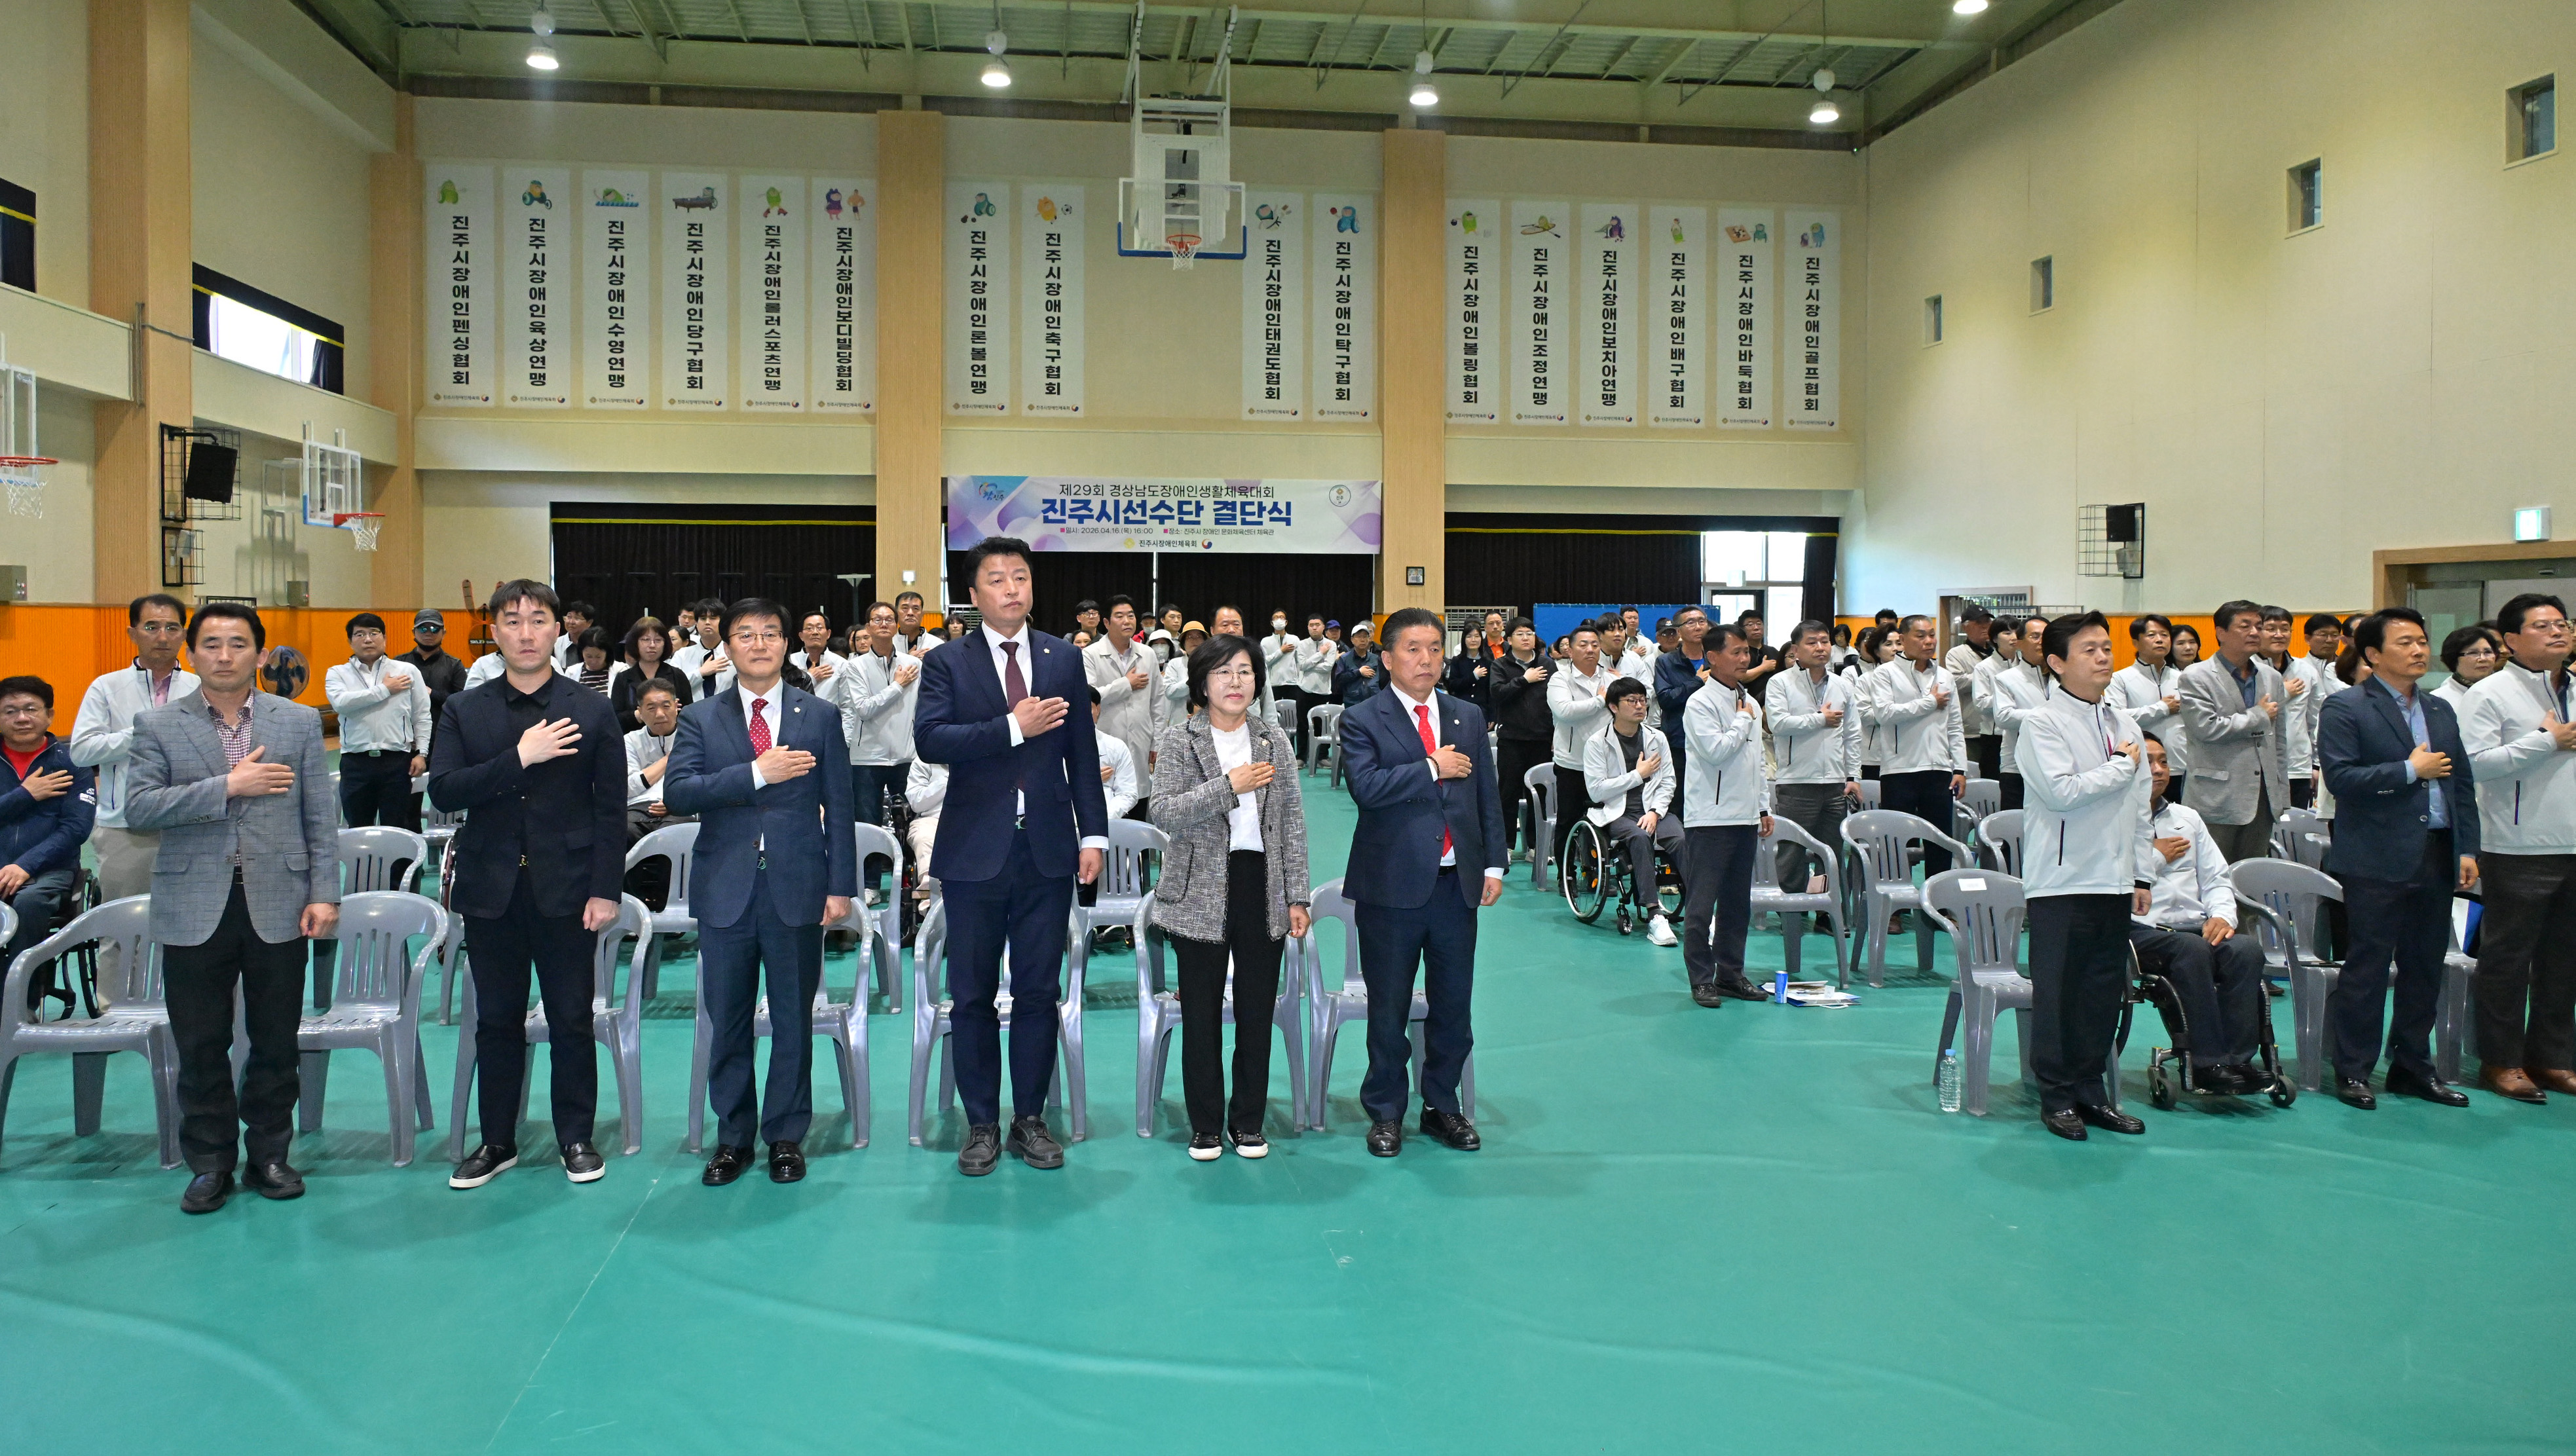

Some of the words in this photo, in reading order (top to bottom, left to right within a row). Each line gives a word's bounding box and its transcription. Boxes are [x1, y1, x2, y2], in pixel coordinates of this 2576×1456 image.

[452, 215, 471, 385] 진주시장애인펜싱협회
[529, 218, 547, 386] 진주시장애인육상연맹
[607, 220, 625, 388] 진주시장애인수영연맹
[686, 223, 704, 390] 진주시장애인당구협회
[836, 227, 853, 392] 진주시장애인보디빌딩협회
[1045, 233, 1062, 396] 진주시장애인축구협회
[1265, 239, 1282, 400] 진주시장애인태권도협회
[1335, 242, 1352, 401] 진주시장애인탁구협회
[1463, 246, 1480, 404] 진주시장애인볼링협회
[1532, 248, 1549, 405] 진주시장애인조정연맹
[1601, 250, 1618, 407] 진주시장애인보치아연맹
[1670, 252, 1686, 408] 진주시장애인배구협회
[1738, 255, 1754, 410] 진주시장애인바둑협회
[1804, 257, 1821, 411] 진주시장애인골프협회
[1041, 498, 1204, 525] 진주시선수단
[1212, 500, 1292, 527] 결단식
[1059, 483, 1104, 496] 제29회
[1110, 484, 1274, 498] 경상남도장애인생활체육대회
[1139, 539, 1197, 548] 진주시장애인체육회
